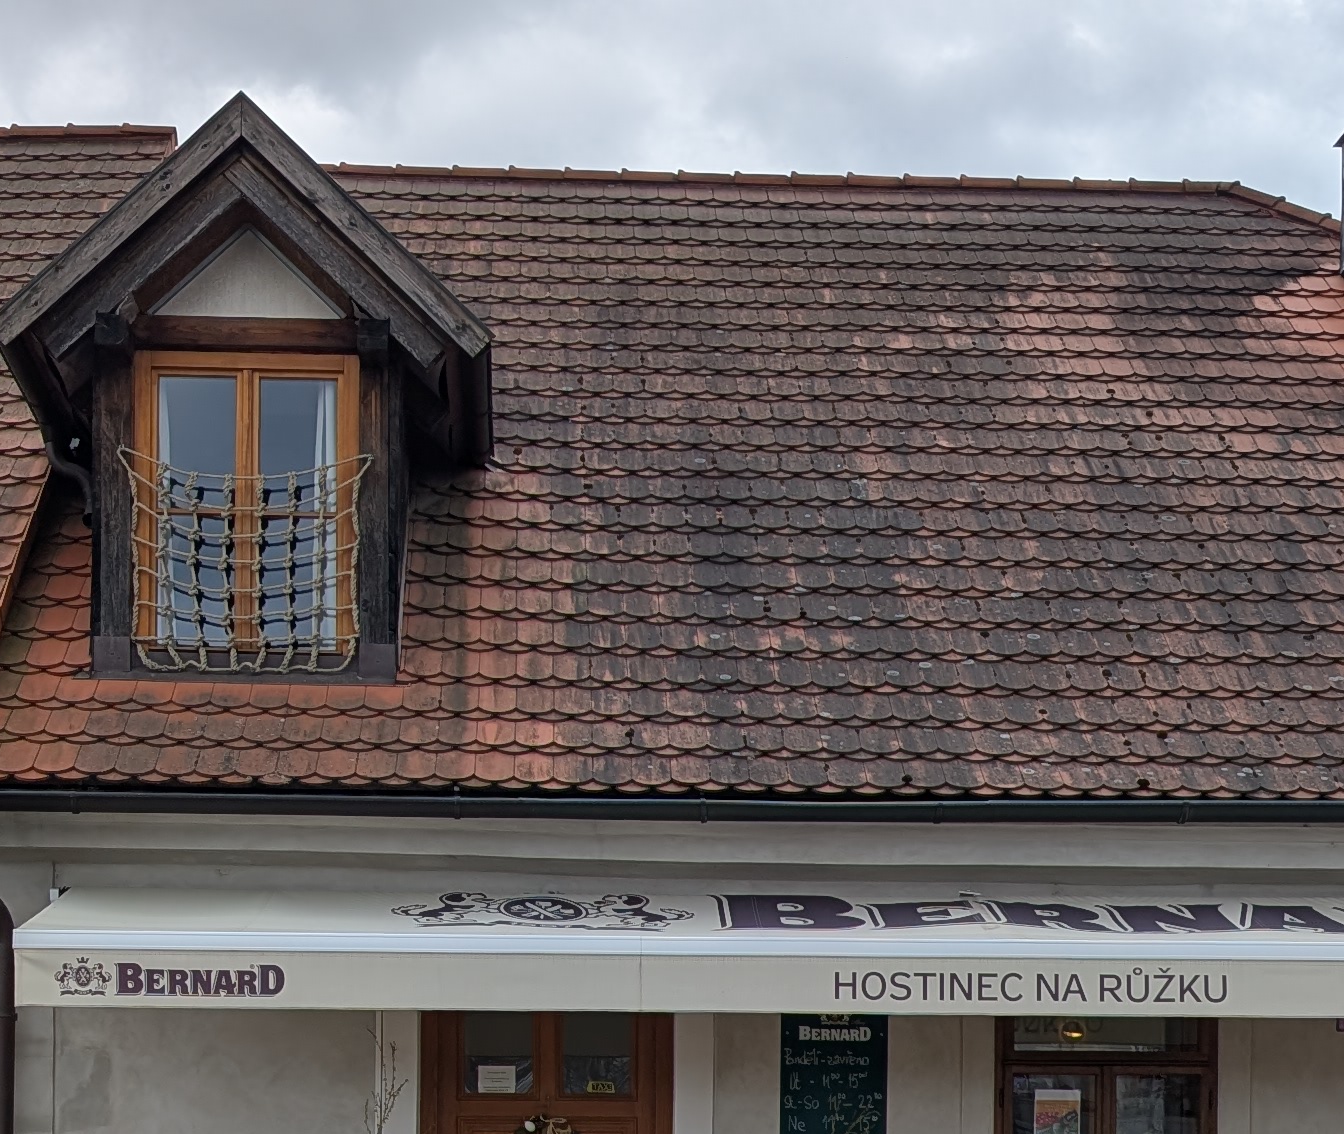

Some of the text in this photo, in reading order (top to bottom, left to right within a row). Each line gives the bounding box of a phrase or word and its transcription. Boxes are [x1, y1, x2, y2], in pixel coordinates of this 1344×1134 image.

[114, 962, 285, 997] BERNARD
[834, 967, 1228, 1004] HOSTINEC NA RŮŽKU
[798, 1025, 872, 1042] BERNARD
